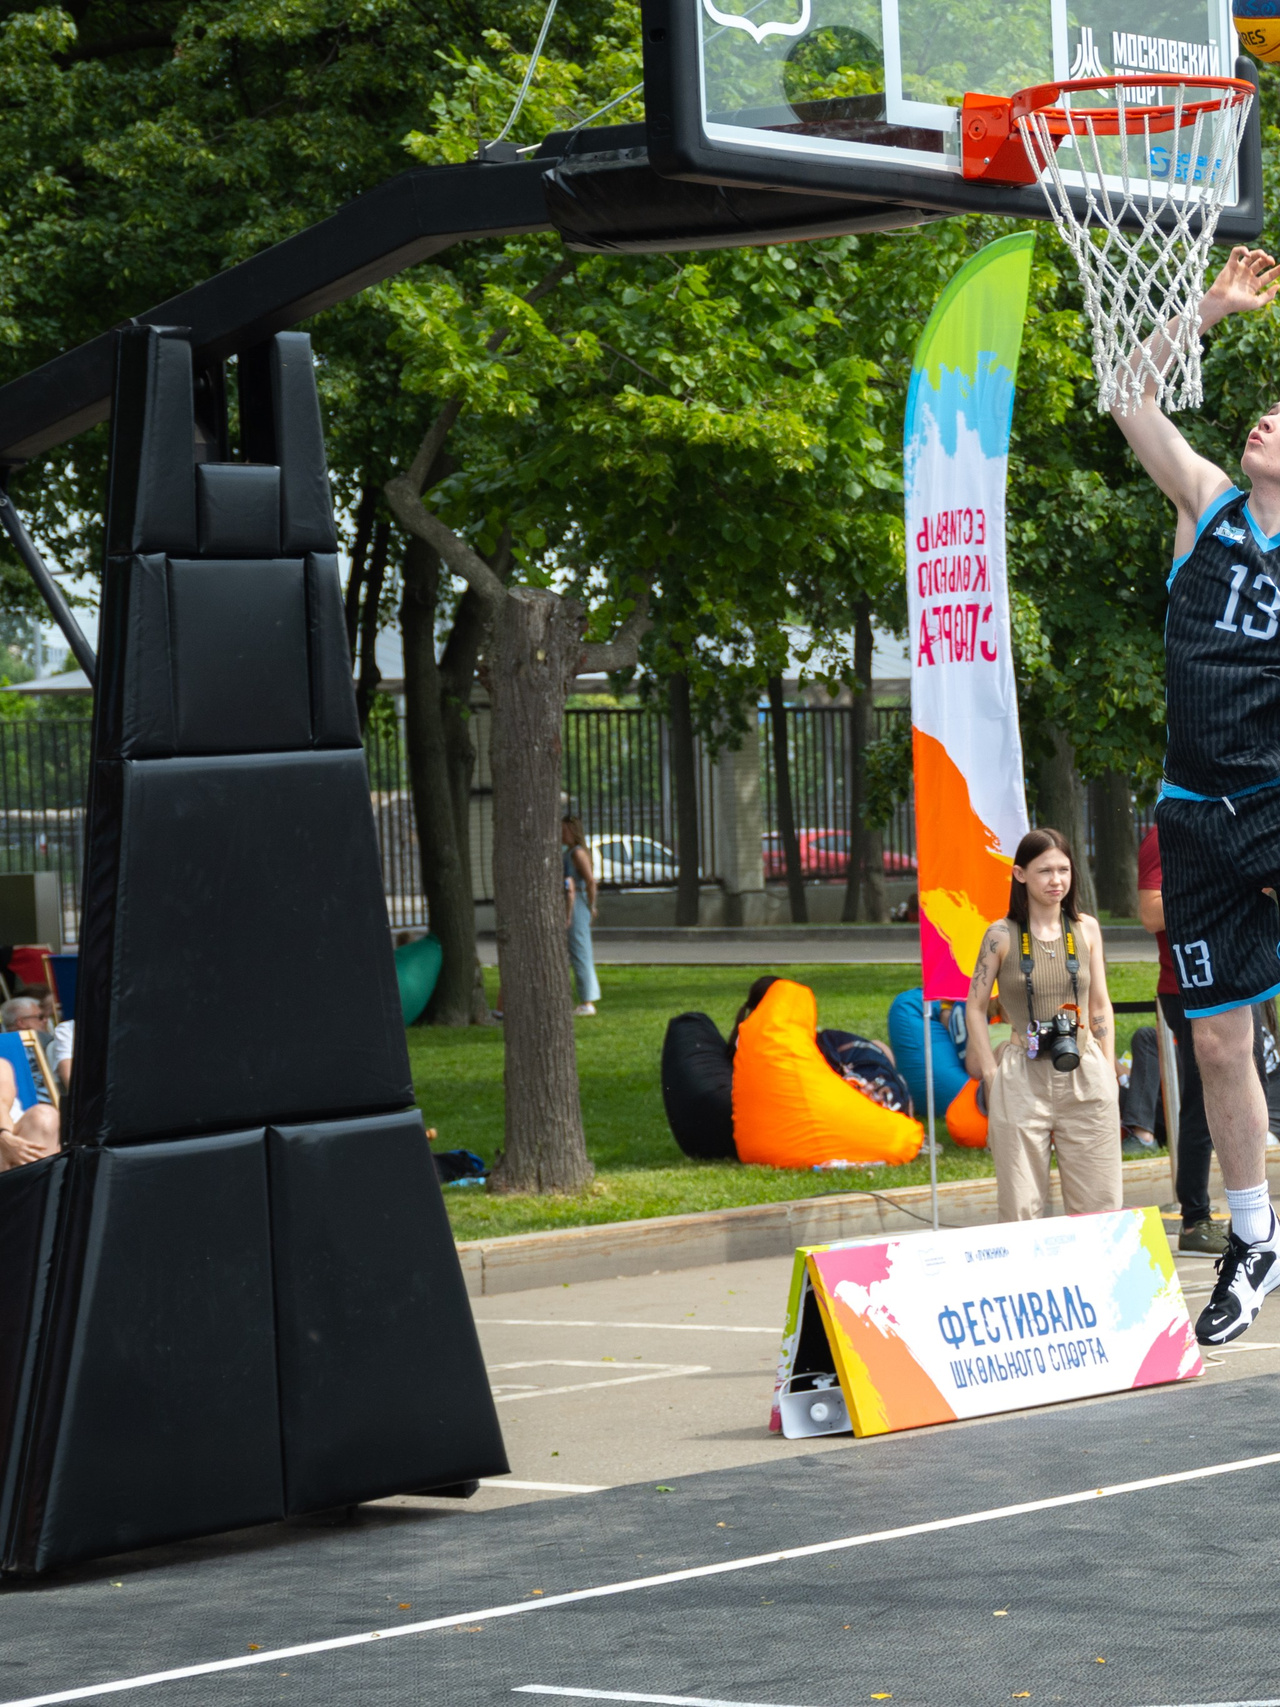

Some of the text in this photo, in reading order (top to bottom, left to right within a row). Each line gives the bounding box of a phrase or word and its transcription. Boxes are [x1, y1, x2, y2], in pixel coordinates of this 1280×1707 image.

[1112, 31, 1220, 77] МОСКОВСКИЙ
[1238, 28, 1266, 46] RES
[1172, 939, 1214, 989] 13
[937, 1285, 1097, 1350] ФЕСТИВАЛЬ
[950, 1337, 1109, 1389] ШКОЛЬНОГО СПОРТА
